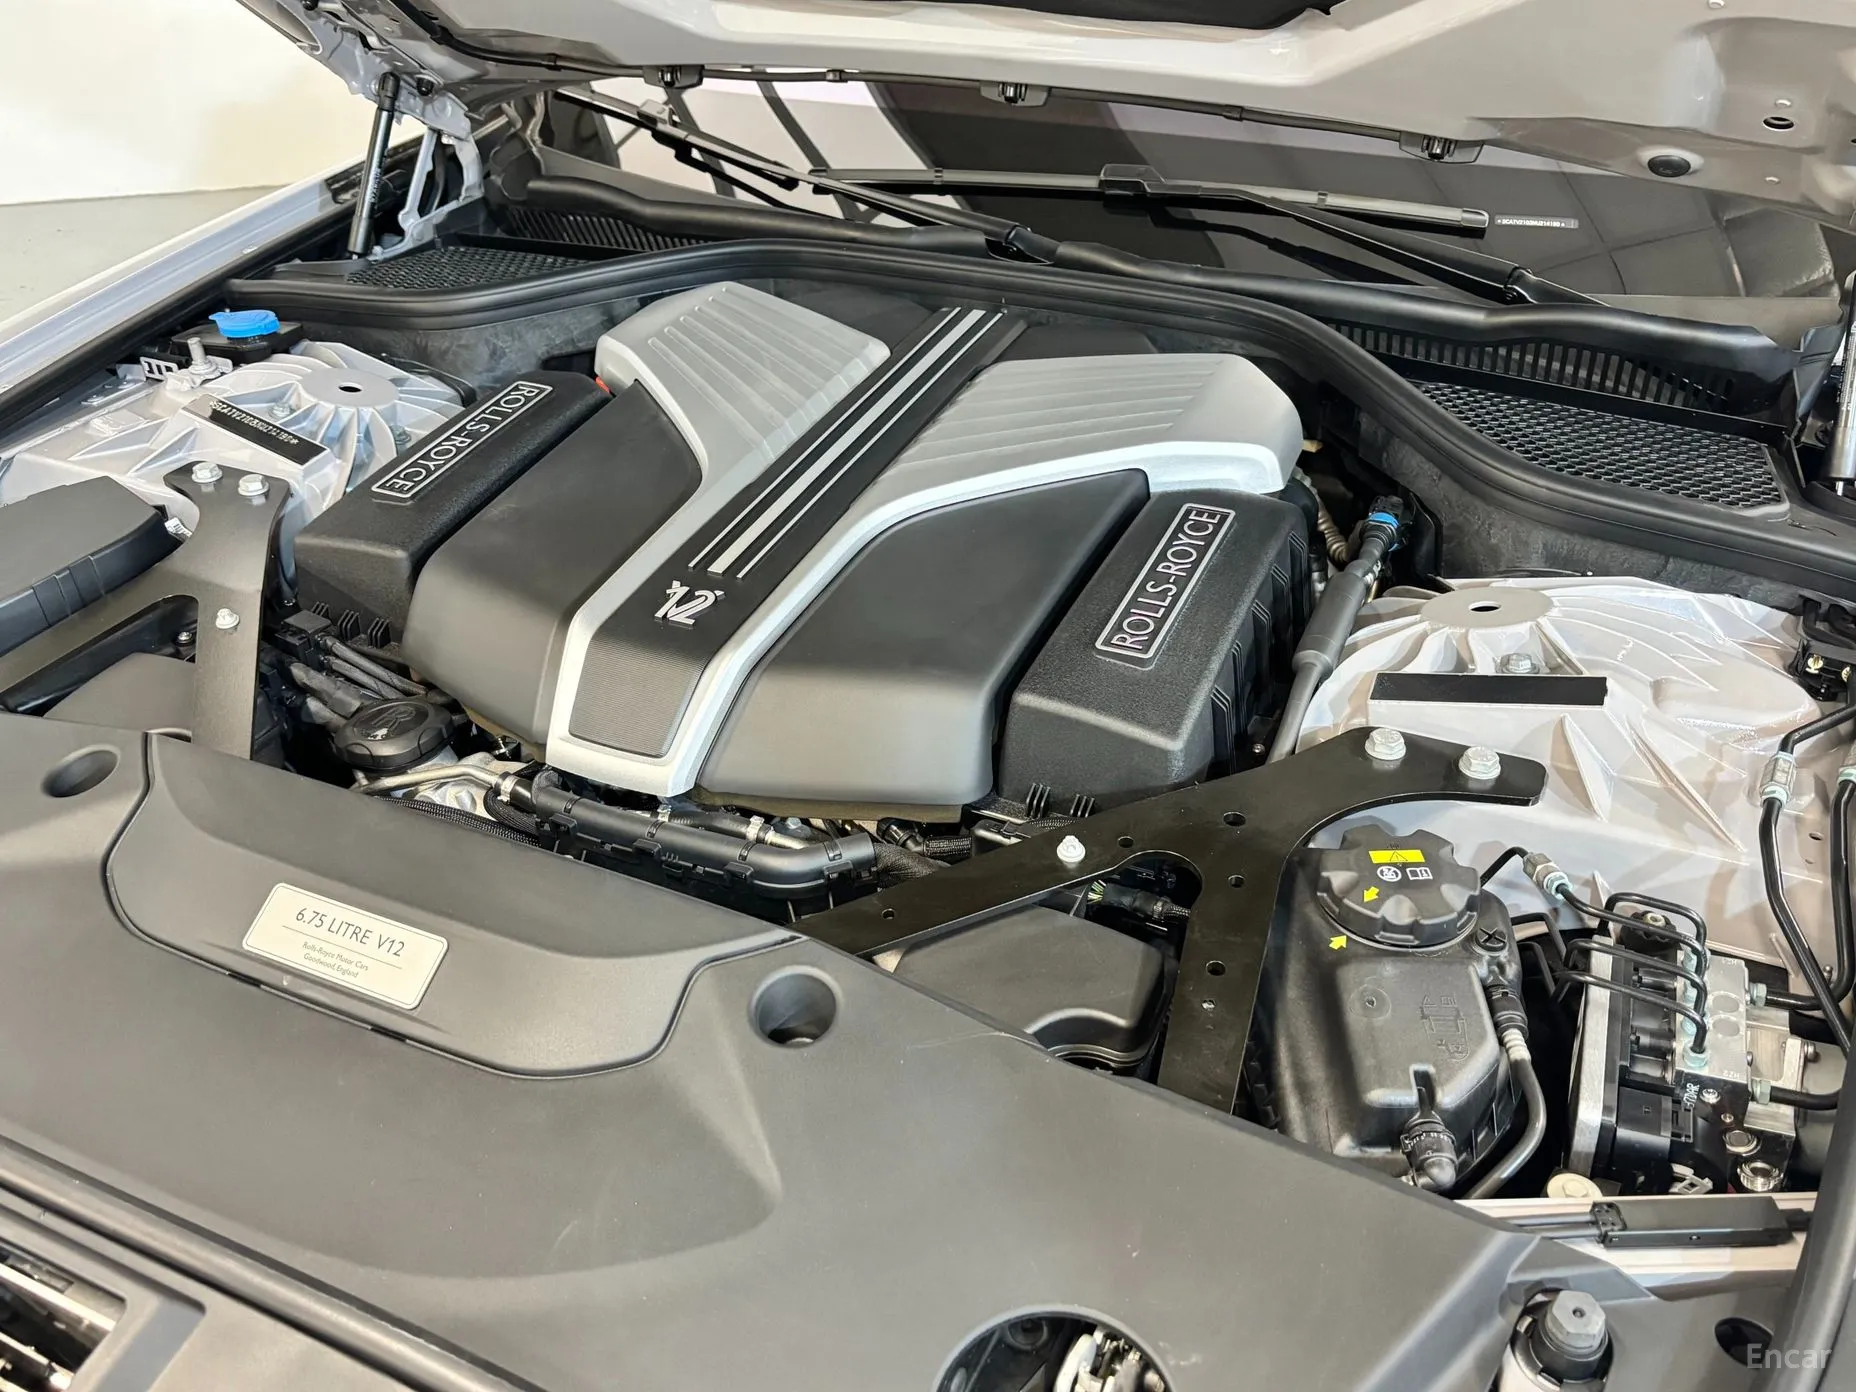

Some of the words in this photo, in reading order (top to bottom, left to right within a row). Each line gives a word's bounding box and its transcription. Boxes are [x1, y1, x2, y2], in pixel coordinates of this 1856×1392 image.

[385, 384, 541, 492] ROLLS-ROYCE
[1110, 510, 1221, 650] ROLLS-ROYCE
[295, 907, 327, 929] 6.75
[327, 917, 373, 945] LITRE
[377, 933, 405, 957] V12
[302, 941, 336, 958] Rolls-Royce
[335, 953, 354, 965] Motor
[355, 961, 369, 972] Cars
[336, 964, 359, 978] England
